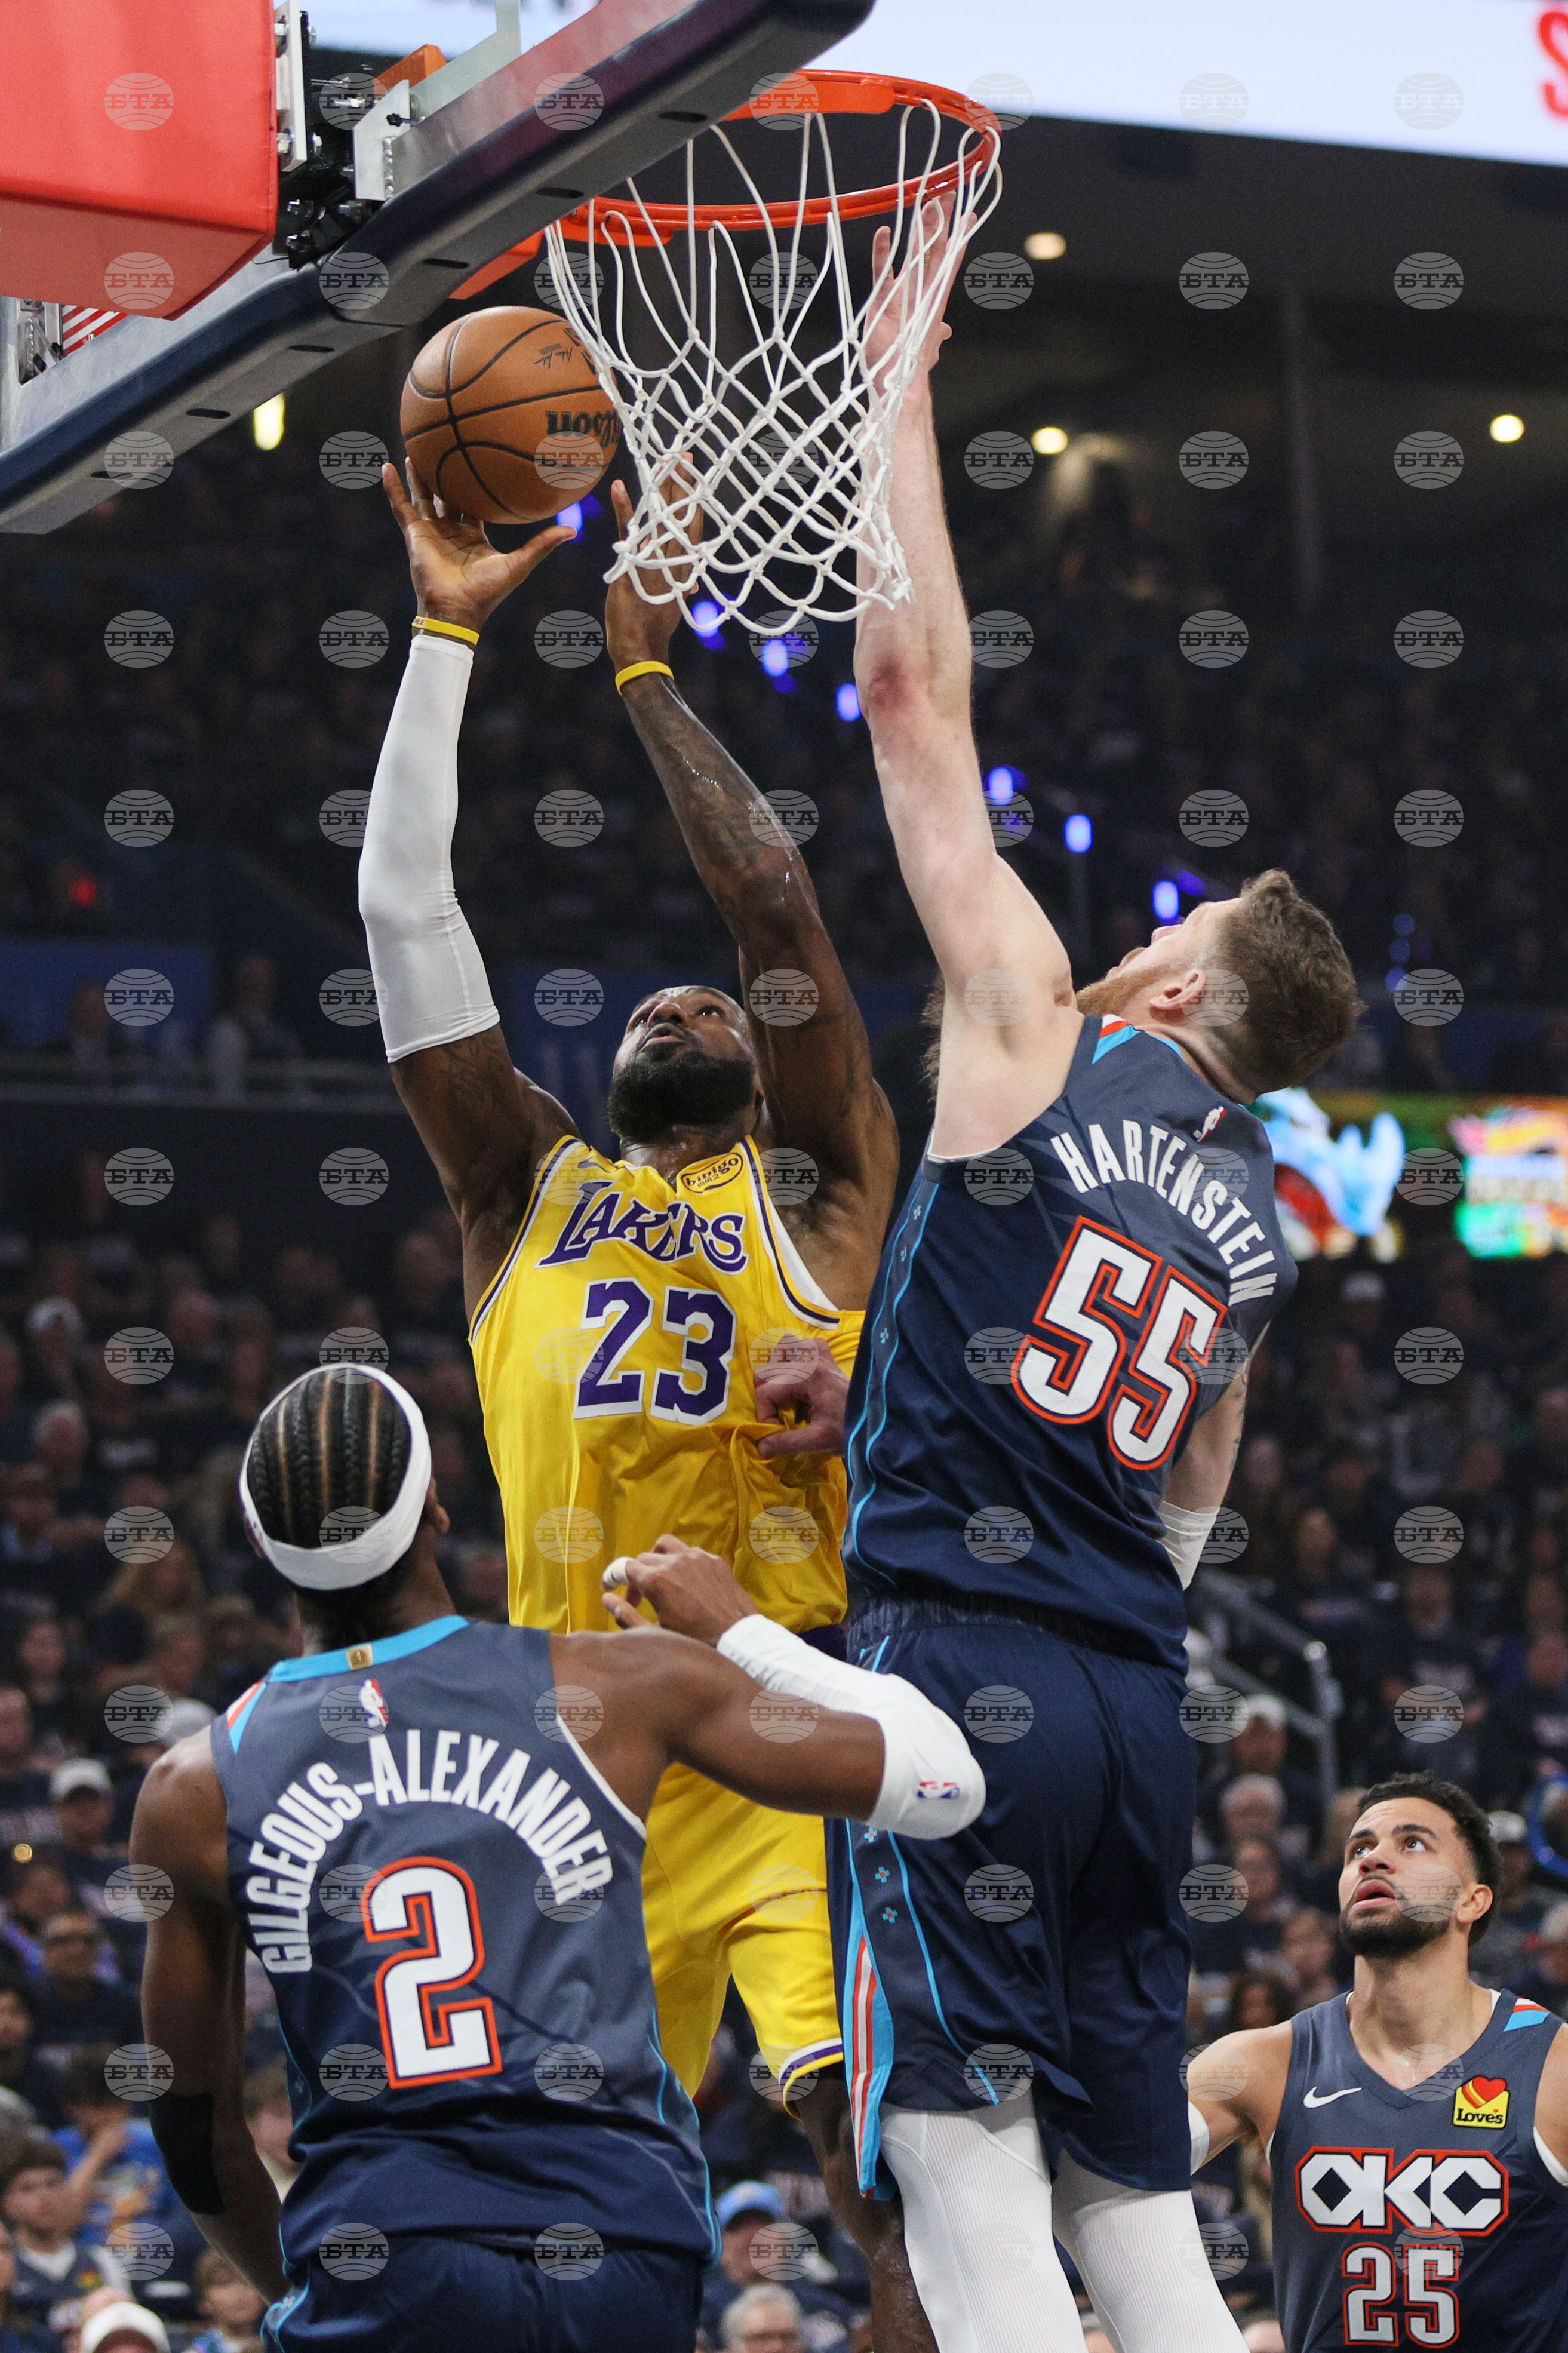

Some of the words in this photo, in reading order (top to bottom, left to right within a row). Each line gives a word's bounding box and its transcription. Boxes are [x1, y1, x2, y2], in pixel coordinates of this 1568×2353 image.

[535, 1179, 749, 1276] LAKERS
[685, 1158, 739, 1186] bibigo
[1050, 1119, 1277, 1306] HARTENSTEIN
[573, 1277, 738, 1426] 23
[1011, 1215, 1228, 1470] 55
[246, 1729, 613, 1973] GILGEOUS-ALEXANDER
[361, 1856, 503, 2090] 2
[1294, 2146, 1509, 2237] OKC
[1341, 2241, 1461, 2349] 25
